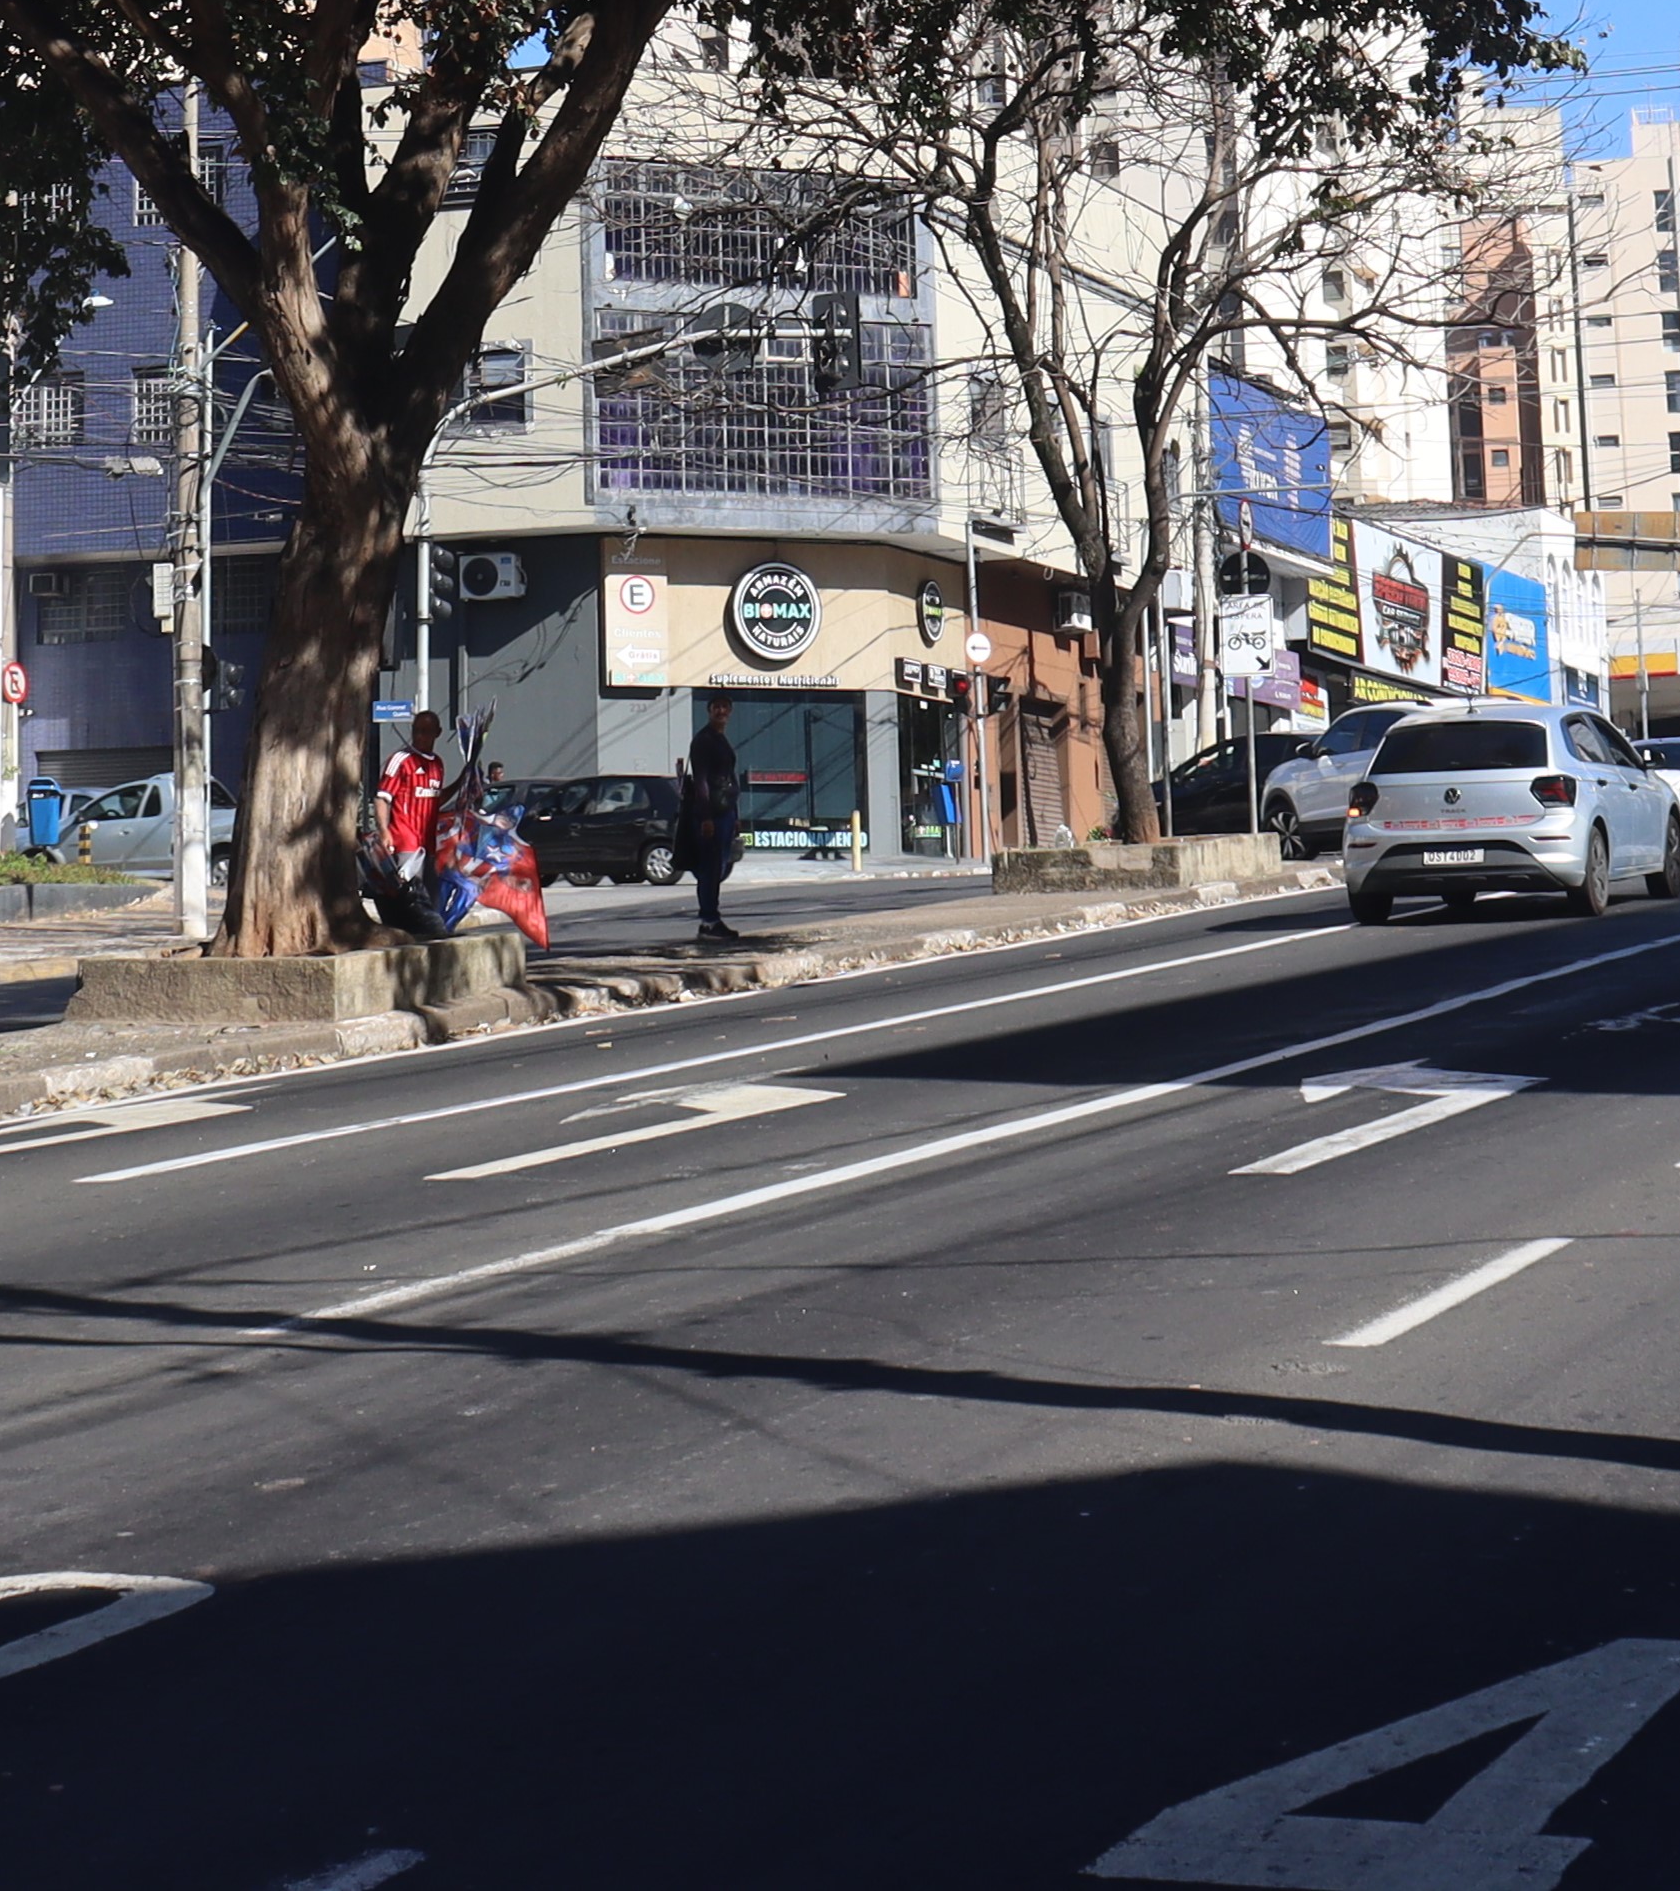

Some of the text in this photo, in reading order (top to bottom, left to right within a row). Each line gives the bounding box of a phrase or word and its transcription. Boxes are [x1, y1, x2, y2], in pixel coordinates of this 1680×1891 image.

[629, 584, 645, 606] E
[750, 574, 805, 598] ARMAZÉM
[752, 625, 805, 647] NATURAIS
[710, 674, 774, 687] Suplementos
[754, 830, 869, 849] ESTACIONAMENO
